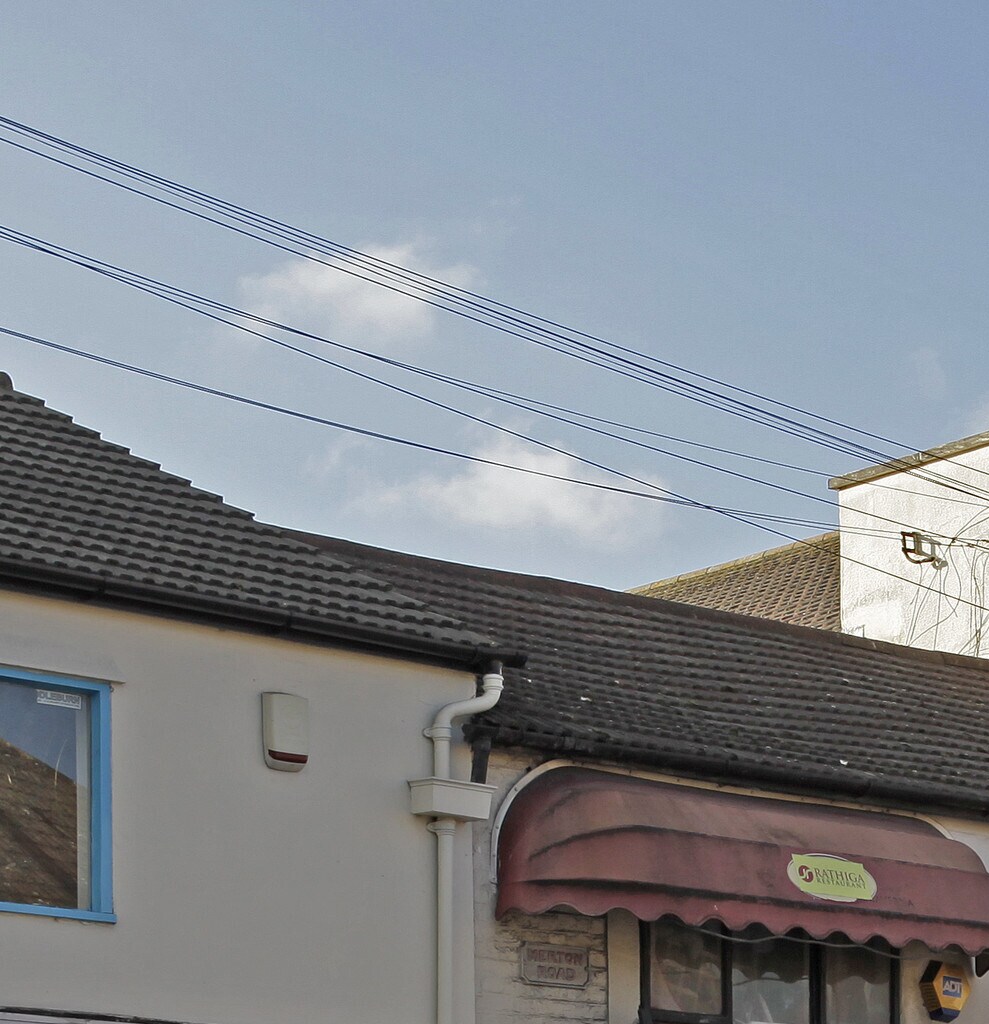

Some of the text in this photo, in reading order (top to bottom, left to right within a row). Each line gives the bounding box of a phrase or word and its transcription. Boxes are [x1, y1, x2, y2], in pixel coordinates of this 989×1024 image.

[814, 868, 865, 883] RATHIGA
[817, 879, 867, 889] RESTAURANT
[528, 949, 584, 966] MERTON
[537, 965, 576, 980] ROAD
[943, 980, 962, 994] ADT
